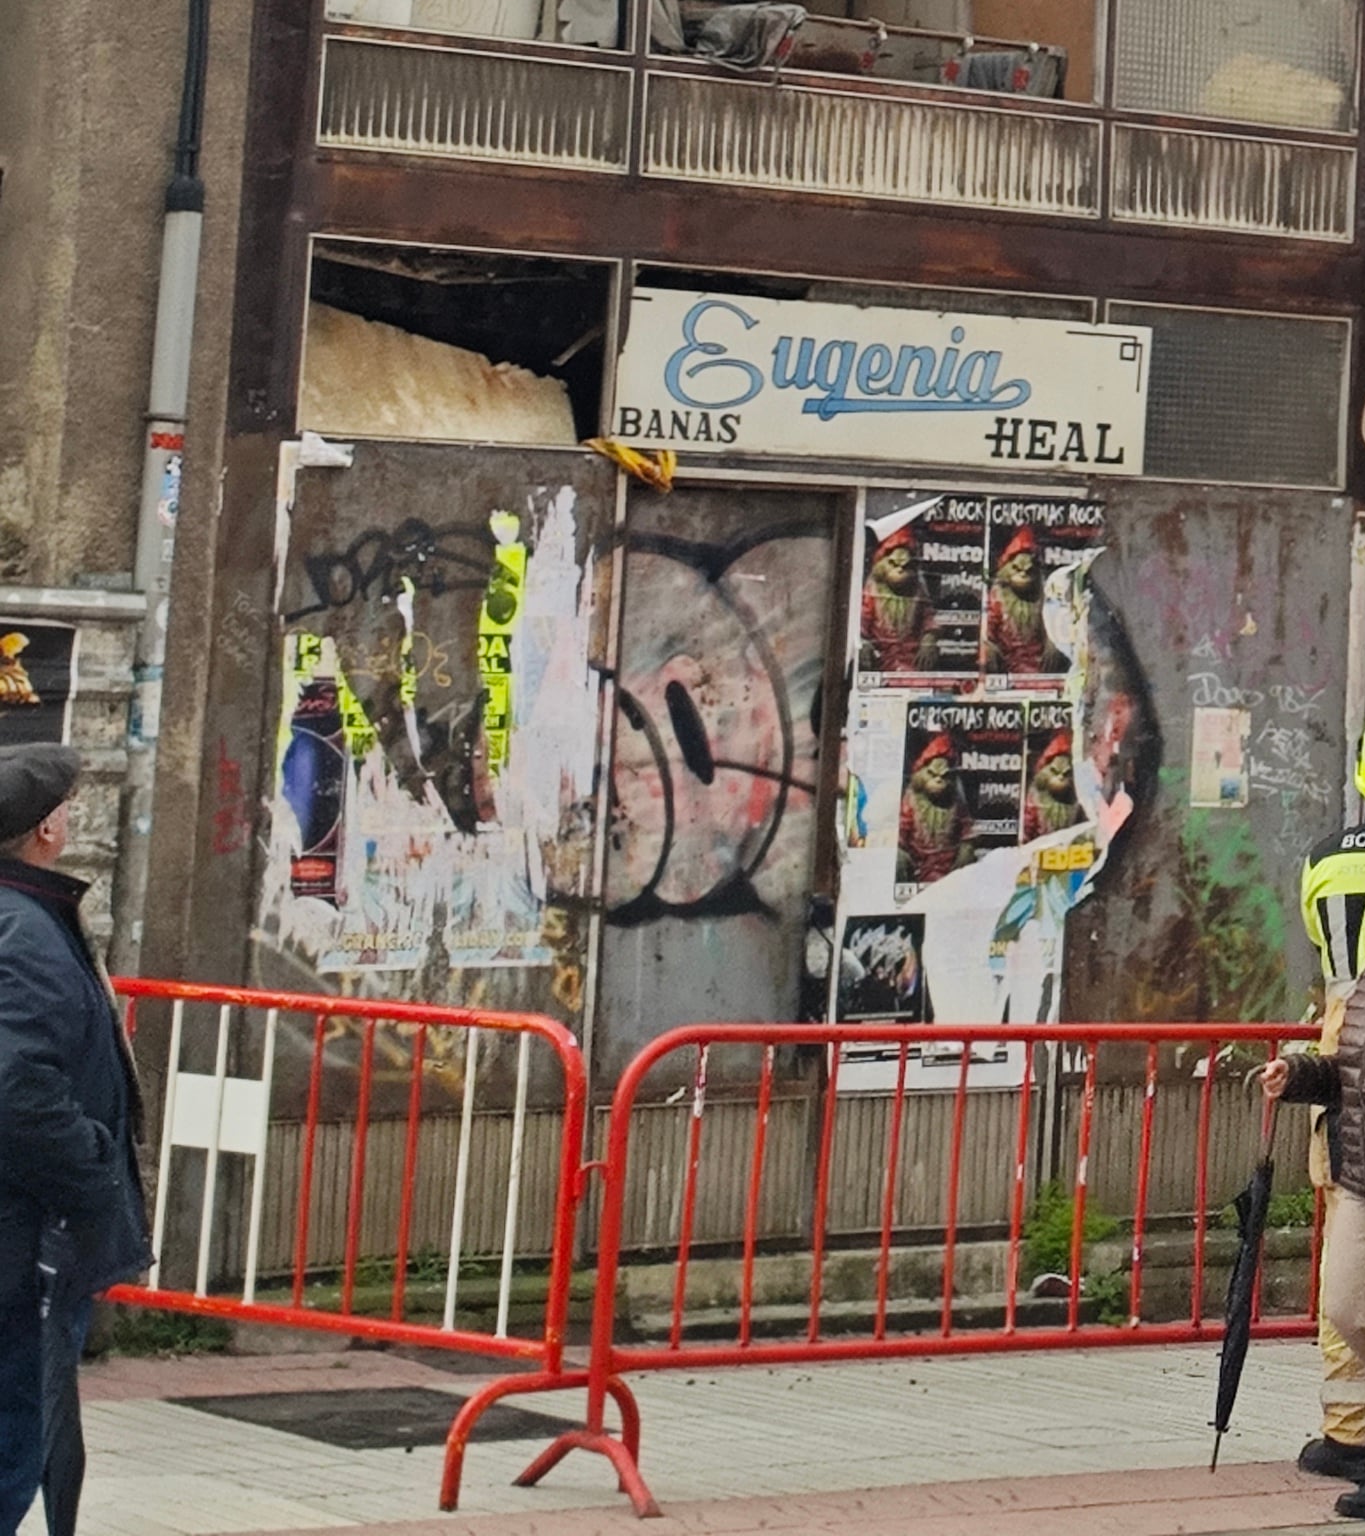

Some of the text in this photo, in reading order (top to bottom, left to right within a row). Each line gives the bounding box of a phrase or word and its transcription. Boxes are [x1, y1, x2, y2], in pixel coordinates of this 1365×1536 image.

[664, 299, 1031, 421] Eugenia
[616, 405, 741, 445] BANAS
[985, 417, 1125, 465] HEAL
[949, 500, 985, 522] ROCK
[992, 503, 1106, 526] CHRISTMAS ROCK
[908, 706, 1024, 731] CHRISTMAS ROCK
